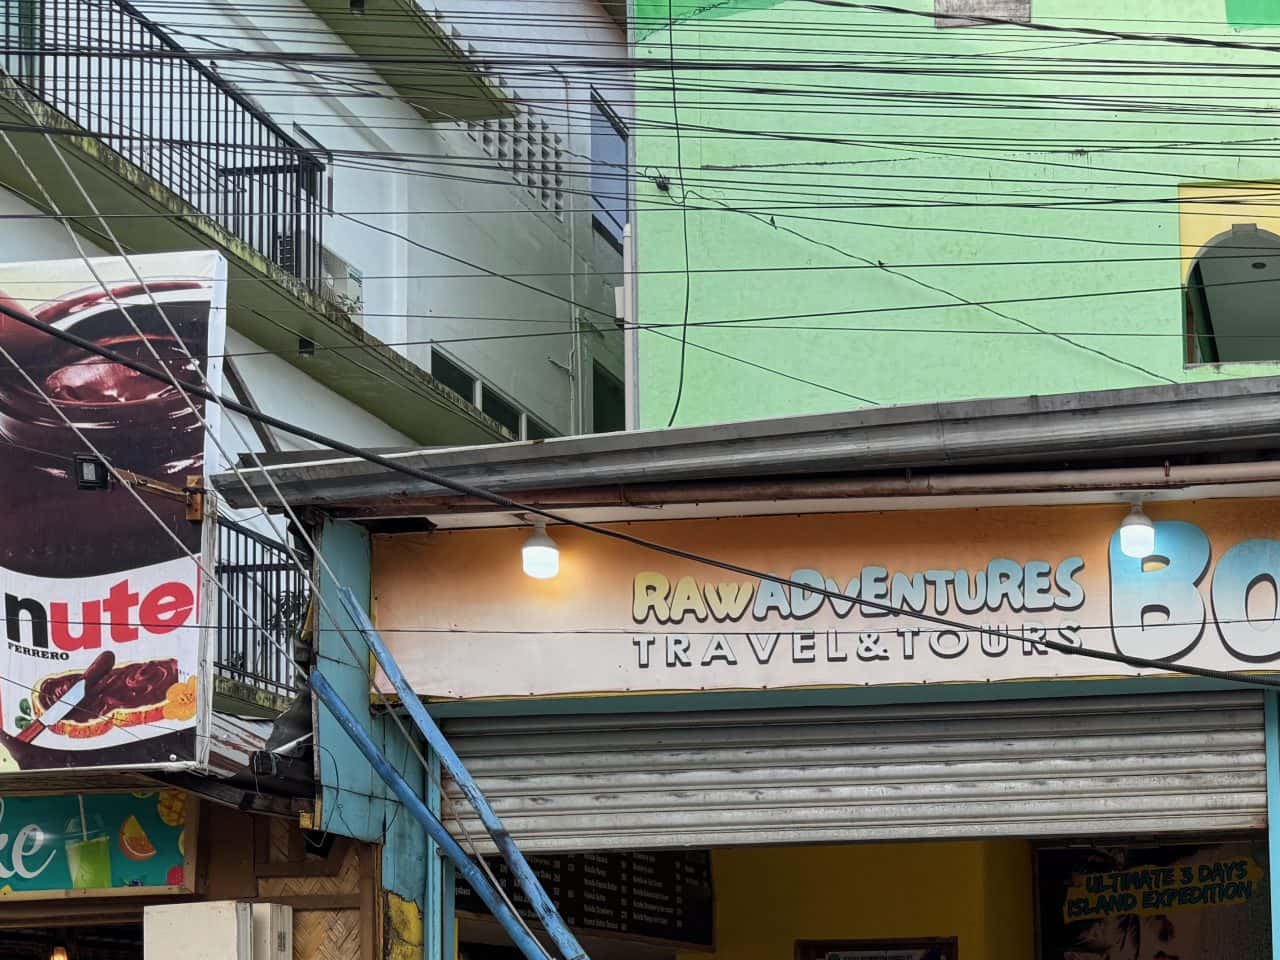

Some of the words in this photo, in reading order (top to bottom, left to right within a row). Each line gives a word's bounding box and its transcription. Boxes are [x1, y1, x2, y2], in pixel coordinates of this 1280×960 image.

[5, 572, 200, 650] nute
[7, 642, 70, 661] FERRERO
[1086, 867, 1173, 892] ULTIMATE
[1199, 861, 1249, 881] DAYS
[1067, 893, 1137, 916] ISLAND
[1142, 880, 1253, 909] EXPEDITION
